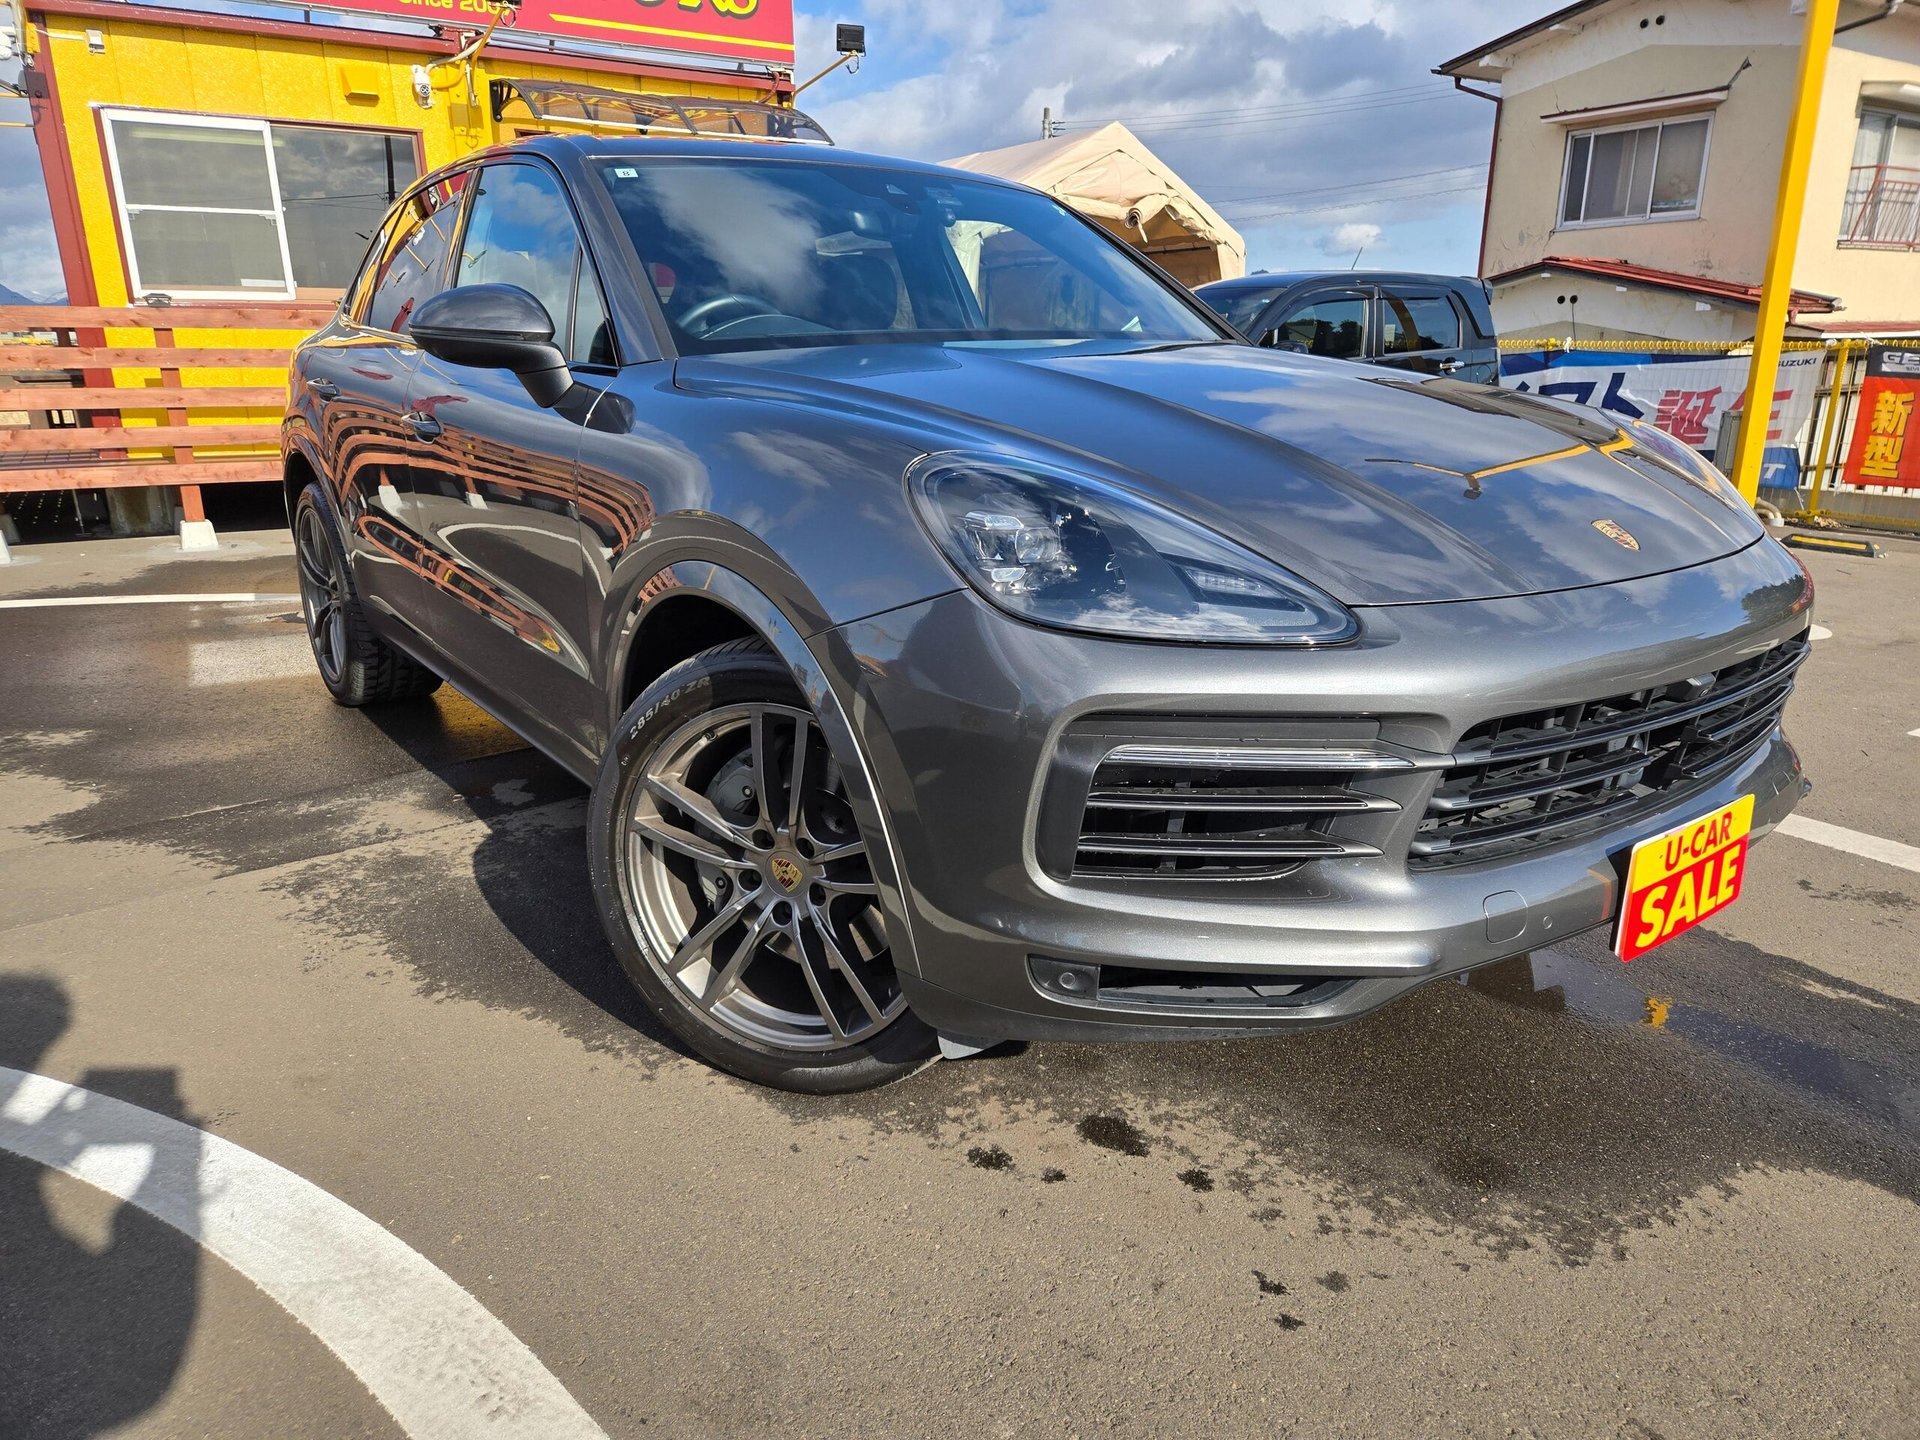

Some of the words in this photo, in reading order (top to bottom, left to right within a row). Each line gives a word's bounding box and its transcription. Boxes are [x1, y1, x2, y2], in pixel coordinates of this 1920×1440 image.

[1860, 390, 1915, 479] 新型
[1664, 811, 1733, 872] U-CAR
[1635, 844, 1741, 948] SALE
